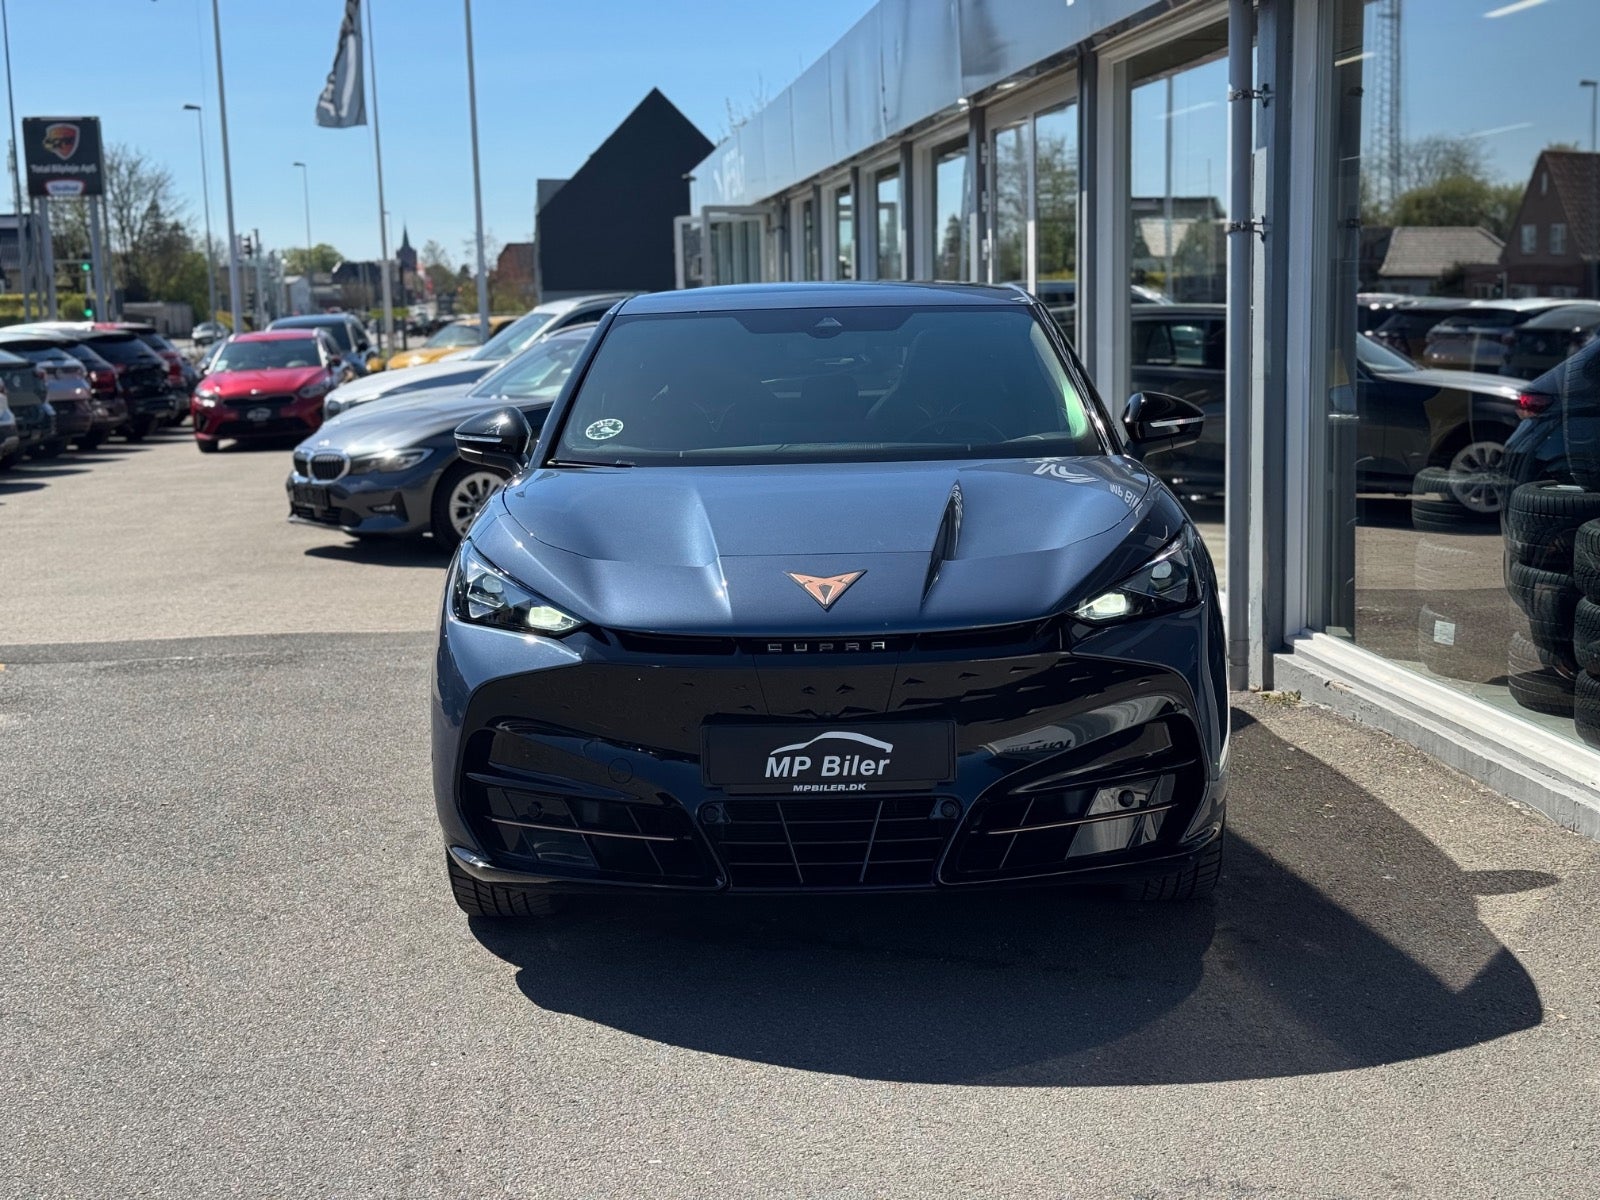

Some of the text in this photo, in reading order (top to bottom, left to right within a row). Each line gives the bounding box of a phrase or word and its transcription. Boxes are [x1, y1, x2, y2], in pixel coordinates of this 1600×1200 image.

[767, 640, 885, 652] CUPRA
[765, 754, 891, 778] MP Biler
[792, 782, 866, 792] MPBILER.DK
